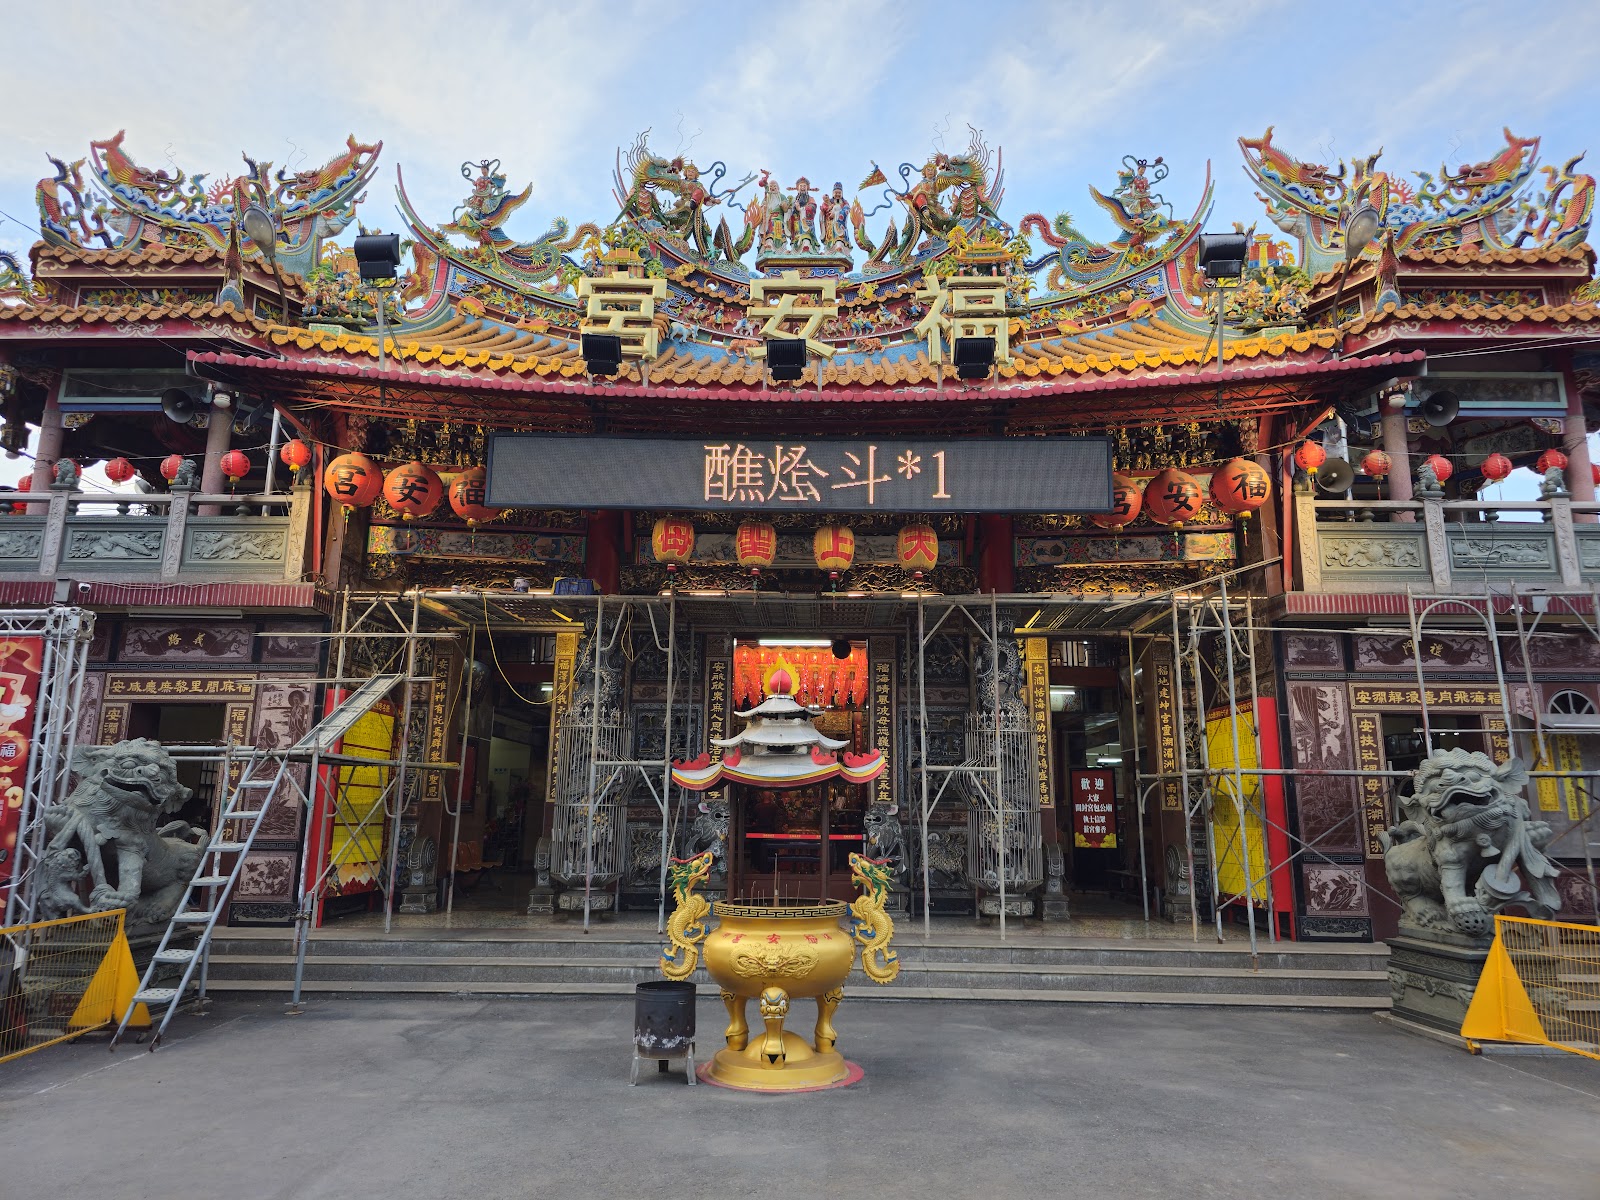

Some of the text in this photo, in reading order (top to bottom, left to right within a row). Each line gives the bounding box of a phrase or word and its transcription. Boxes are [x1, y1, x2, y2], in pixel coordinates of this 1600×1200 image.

[331, 459, 367, 496] 宮
[392, 467, 429, 505] 安
[1163, 477, 1199, 512] 安
[1231, 466, 1268, 499] 福
[658, 519, 938, 561] 天 上 聖 母
